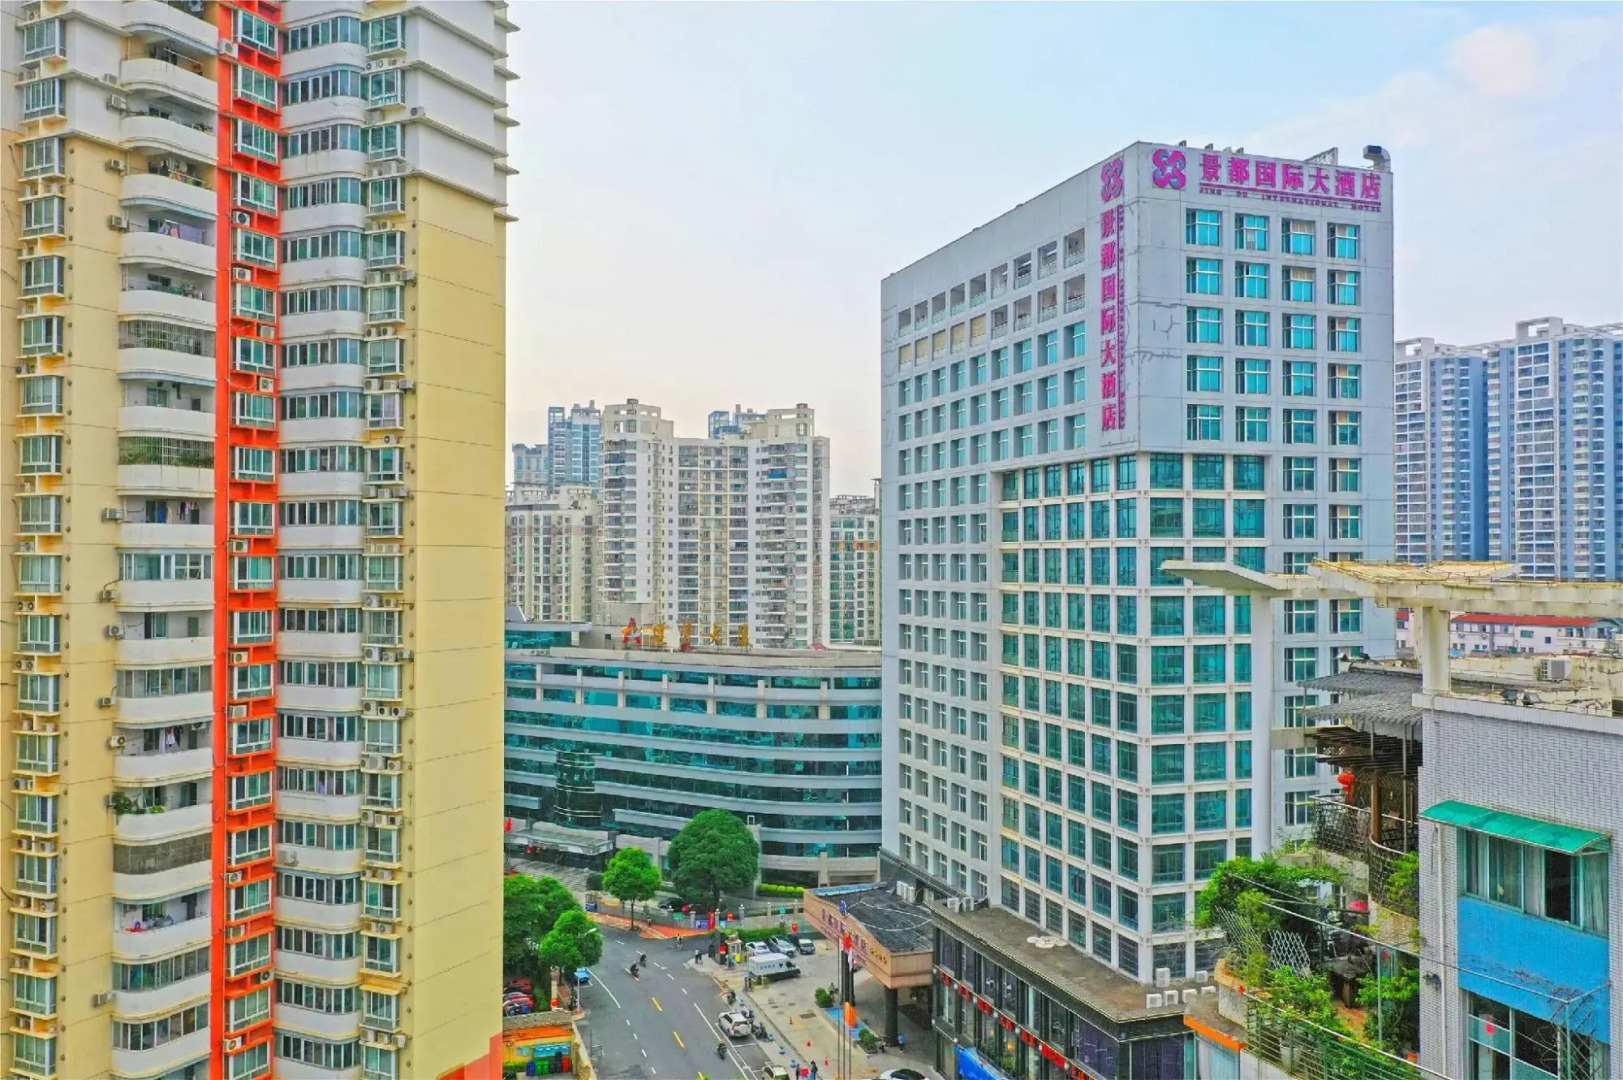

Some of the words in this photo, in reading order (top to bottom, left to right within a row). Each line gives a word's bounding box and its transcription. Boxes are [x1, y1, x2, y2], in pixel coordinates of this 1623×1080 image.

[1200, 153, 1381, 199] 景都国际大酒店
[1100, 208, 1116, 431] 景都国际大酒店
